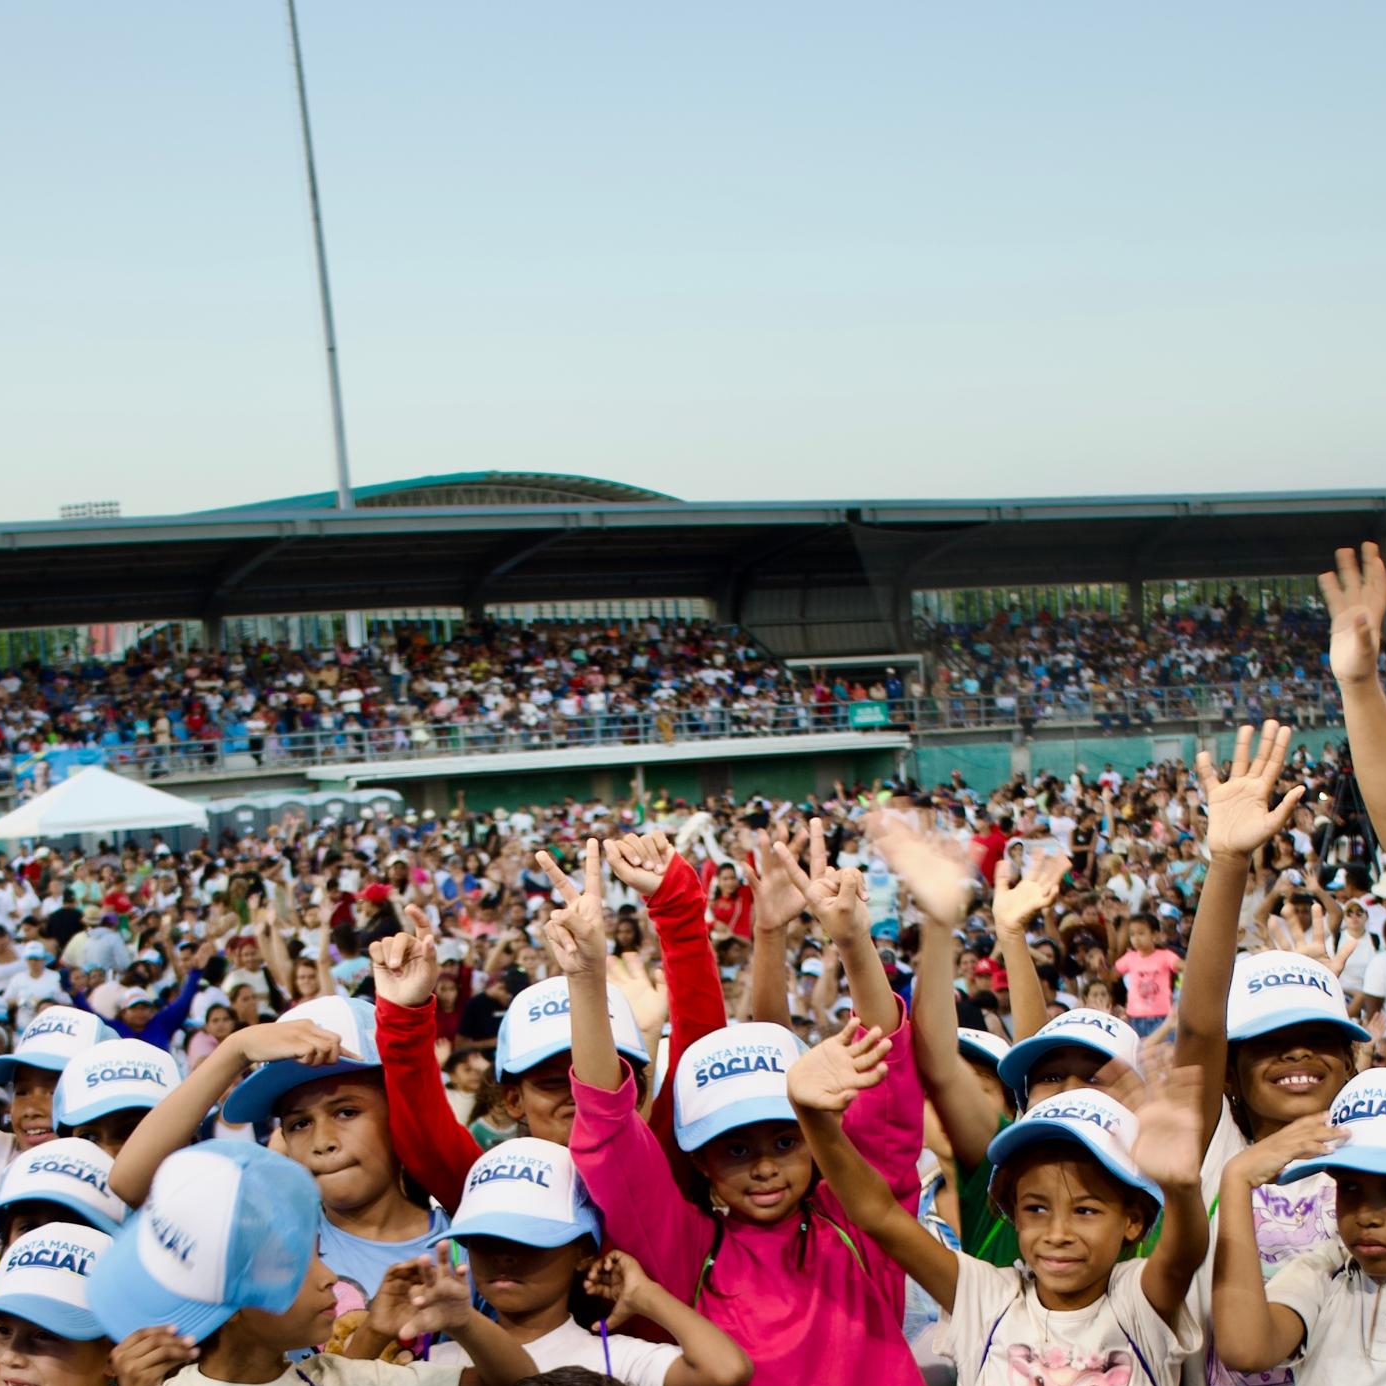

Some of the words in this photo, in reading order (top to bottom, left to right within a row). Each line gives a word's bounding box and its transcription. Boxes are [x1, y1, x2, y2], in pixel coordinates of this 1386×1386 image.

[1247, 973, 1333, 997] SOCIAL
[693, 1047, 731, 1070] SANTA
[736, 1045, 783, 1058] MARTA
[85, 1066, 167, 1088] SOCIAL
[695, 1056, 785, 1088] SOCIAL
[1032, 1107, 1116, 1136] SOCIAL
[506, 1154, 553, 1172] MARTA
[27, 1161, 111, 1198] SOCIAL
[469, 1164, 550, 1193] SOCIAL
[6, 1248, 90, 1277] SOCIAL
[12, 1240, 46, 1256] SANTA
[49, 1239, 97, 1260] MARTA
